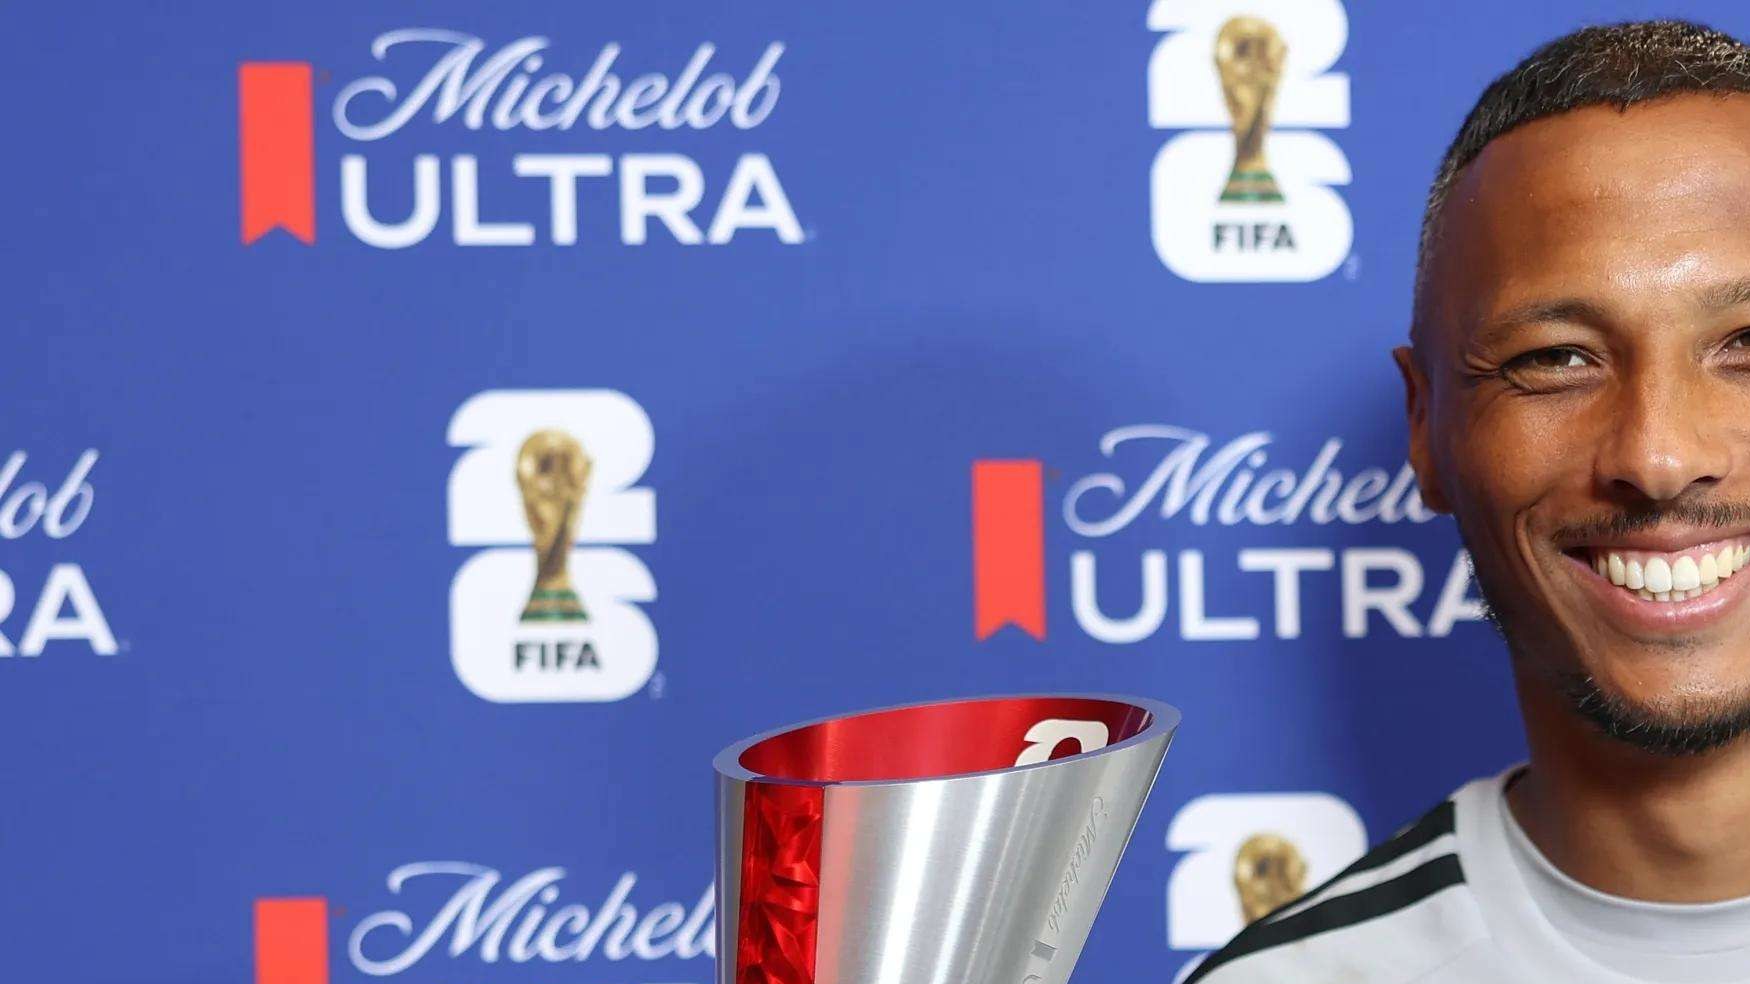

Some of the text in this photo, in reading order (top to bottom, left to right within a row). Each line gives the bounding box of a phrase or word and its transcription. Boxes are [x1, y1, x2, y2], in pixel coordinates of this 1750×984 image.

[333, 28, 786, 141] Michelob
[340, 153, 806, 249] ULTRA
[1212, 223, 1297, 252] FIFA
[513, 641, 603, 672] FIFA
[348, 861, 719, 977] Michel
